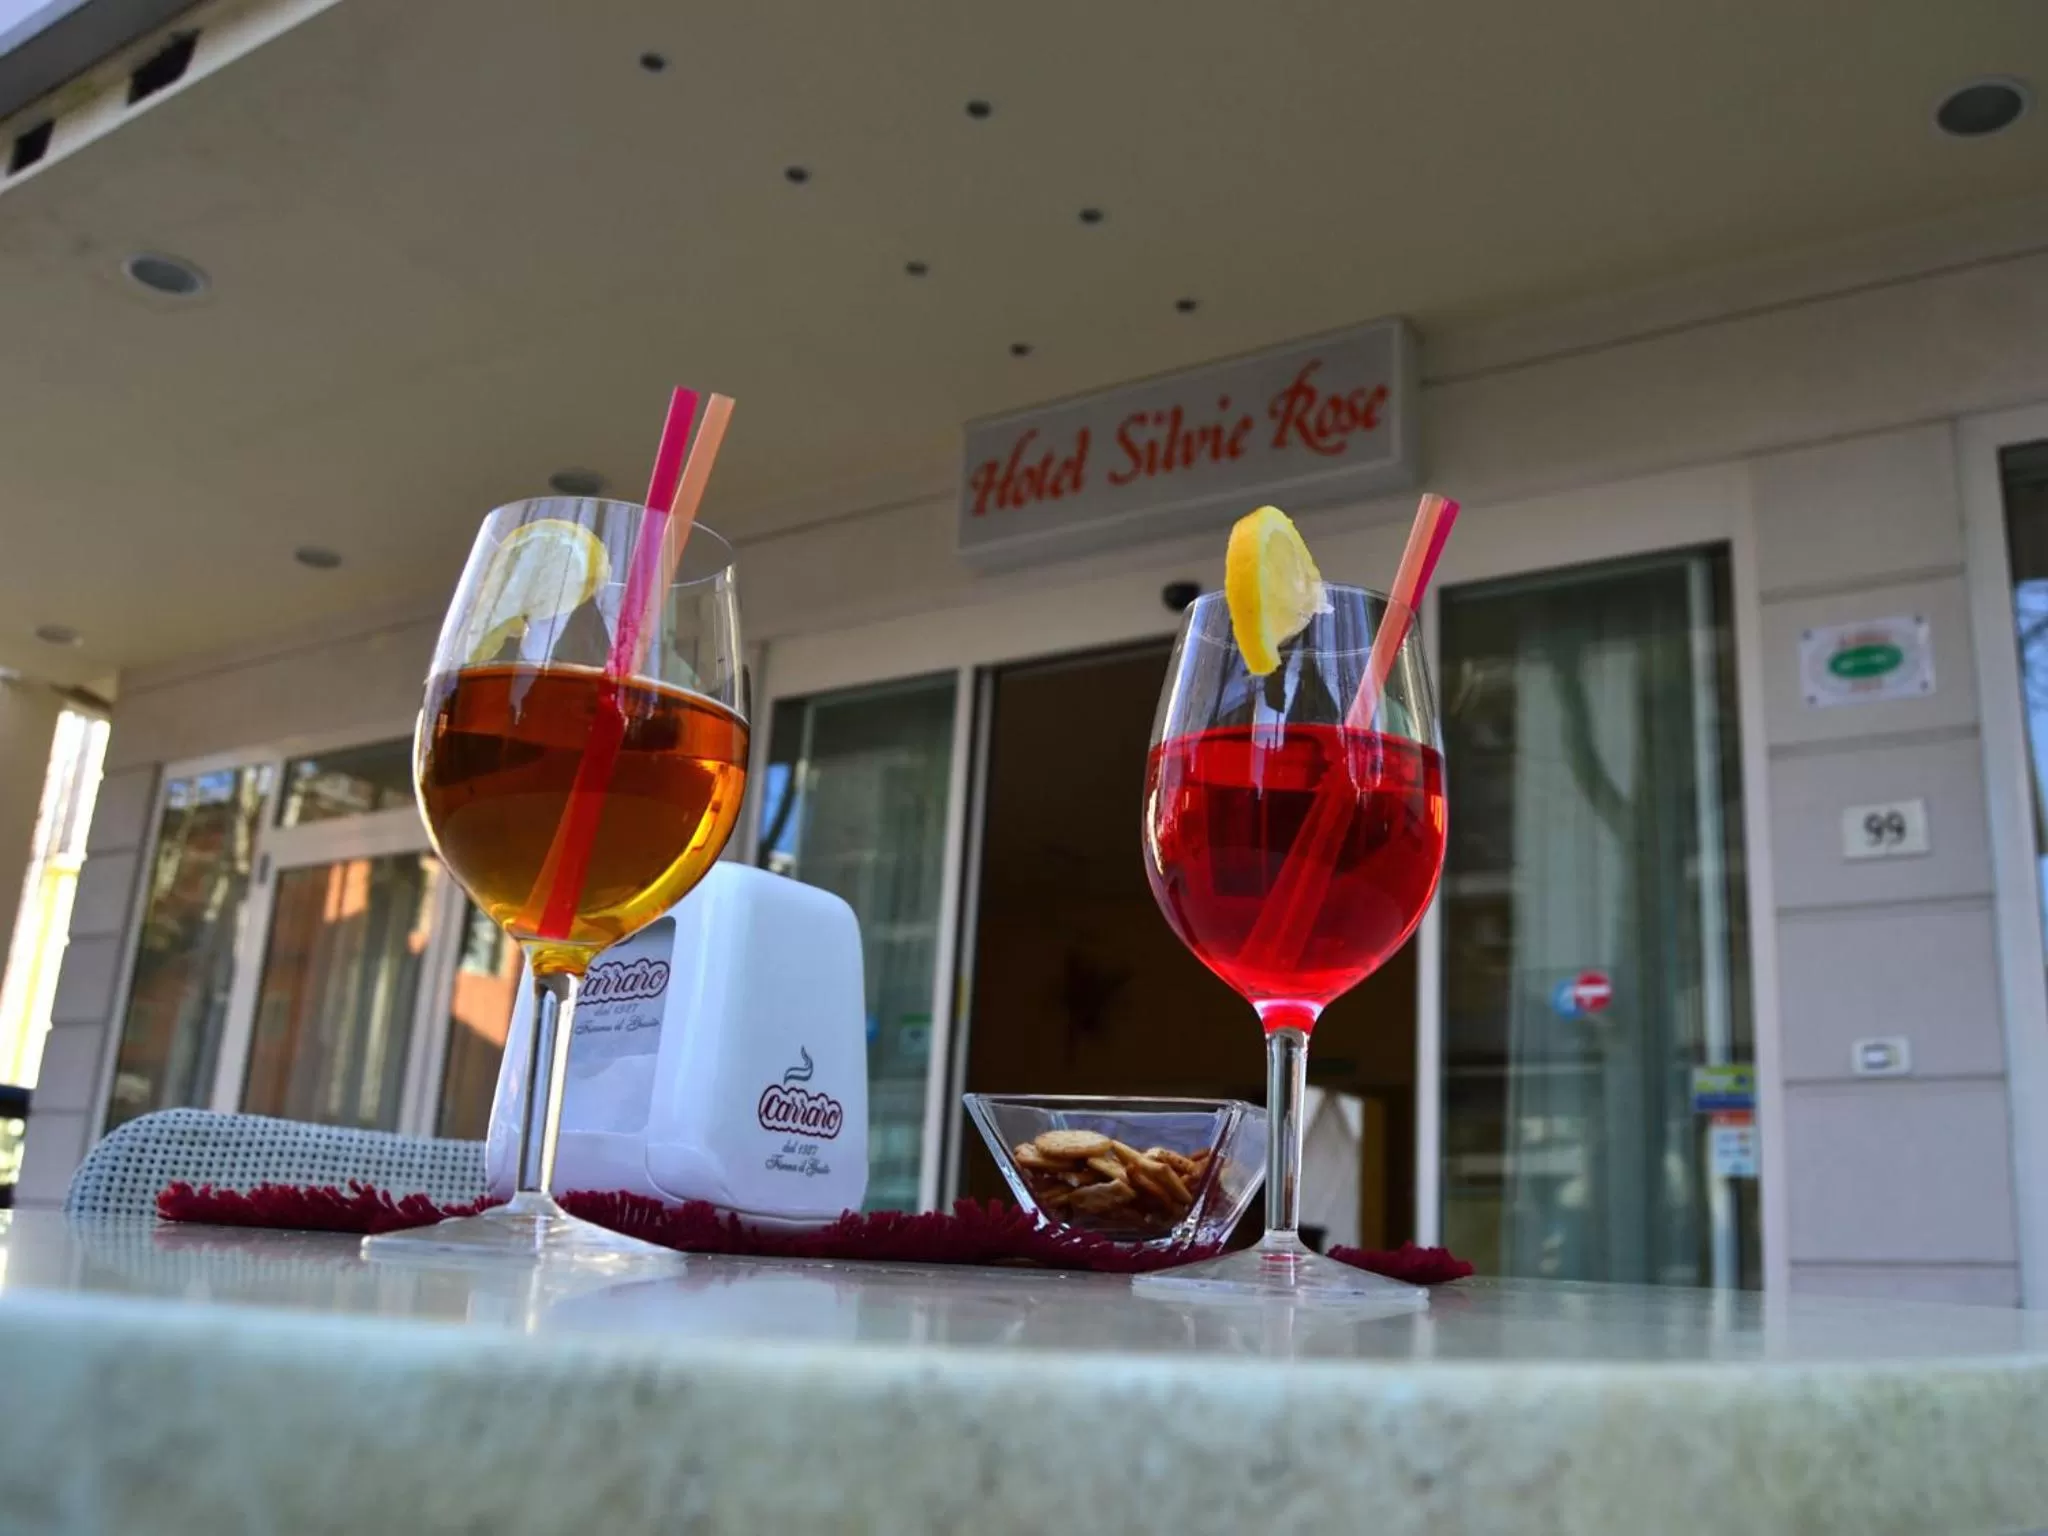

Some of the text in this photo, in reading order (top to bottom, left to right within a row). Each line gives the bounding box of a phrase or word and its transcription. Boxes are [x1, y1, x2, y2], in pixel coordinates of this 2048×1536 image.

[970, 358, 1391, 516] Hotel Silvie Rose
[1863, 810, 1907, 847] 99
[763, 1093, 839, 1131] Carraro
